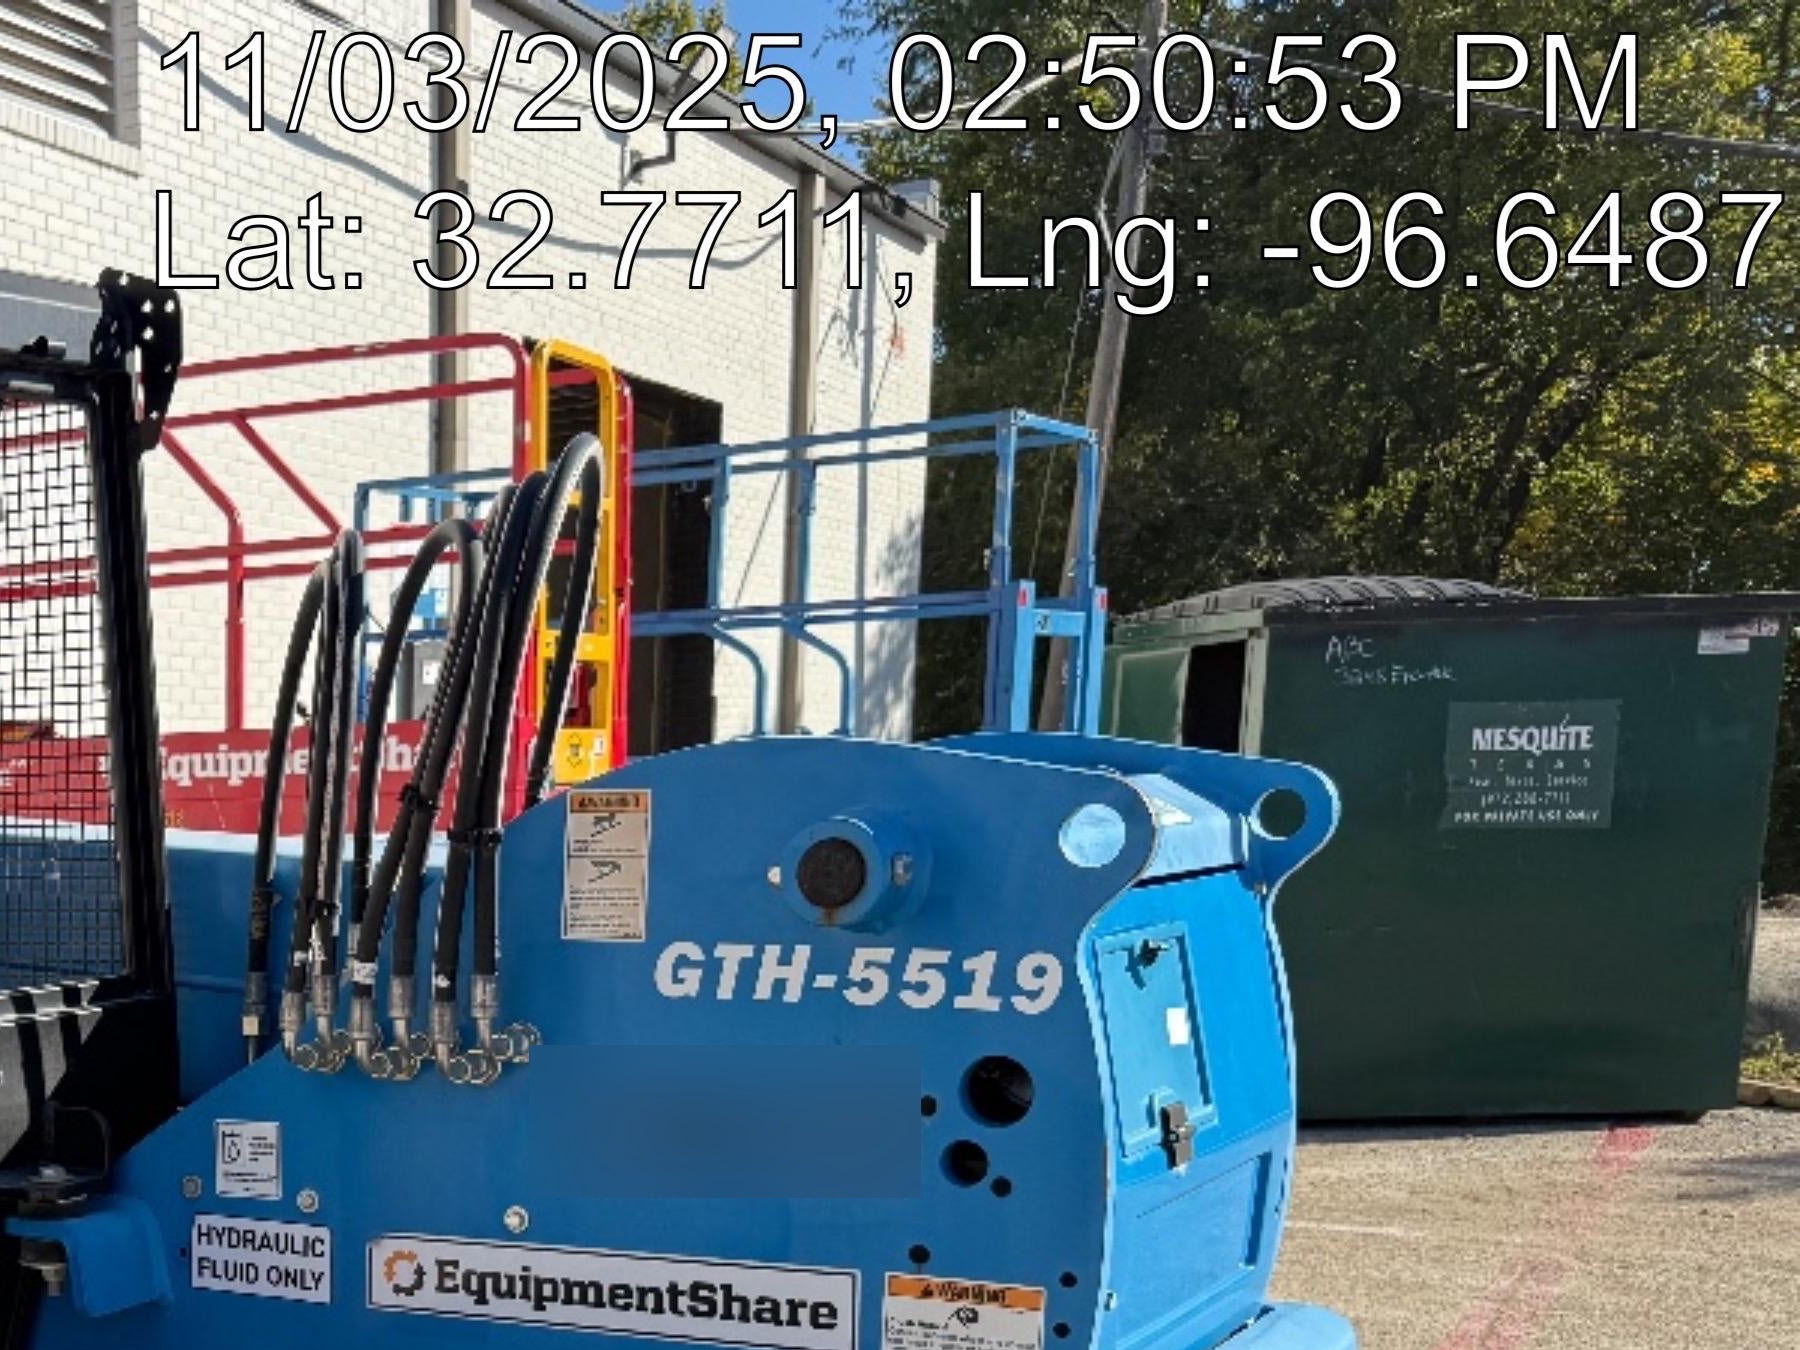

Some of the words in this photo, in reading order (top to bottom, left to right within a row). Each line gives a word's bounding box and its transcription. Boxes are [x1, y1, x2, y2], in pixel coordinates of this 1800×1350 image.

[653, 941, 1063, 1015] GTH-5519
[197, 1223, 326, 1258] HYDRAULIC
[197, 1256, 259, 1285] FLUID
[266, 1265, 325, 1291] ONLY
[435, 1258, 839, 1331] EquipmentShare
